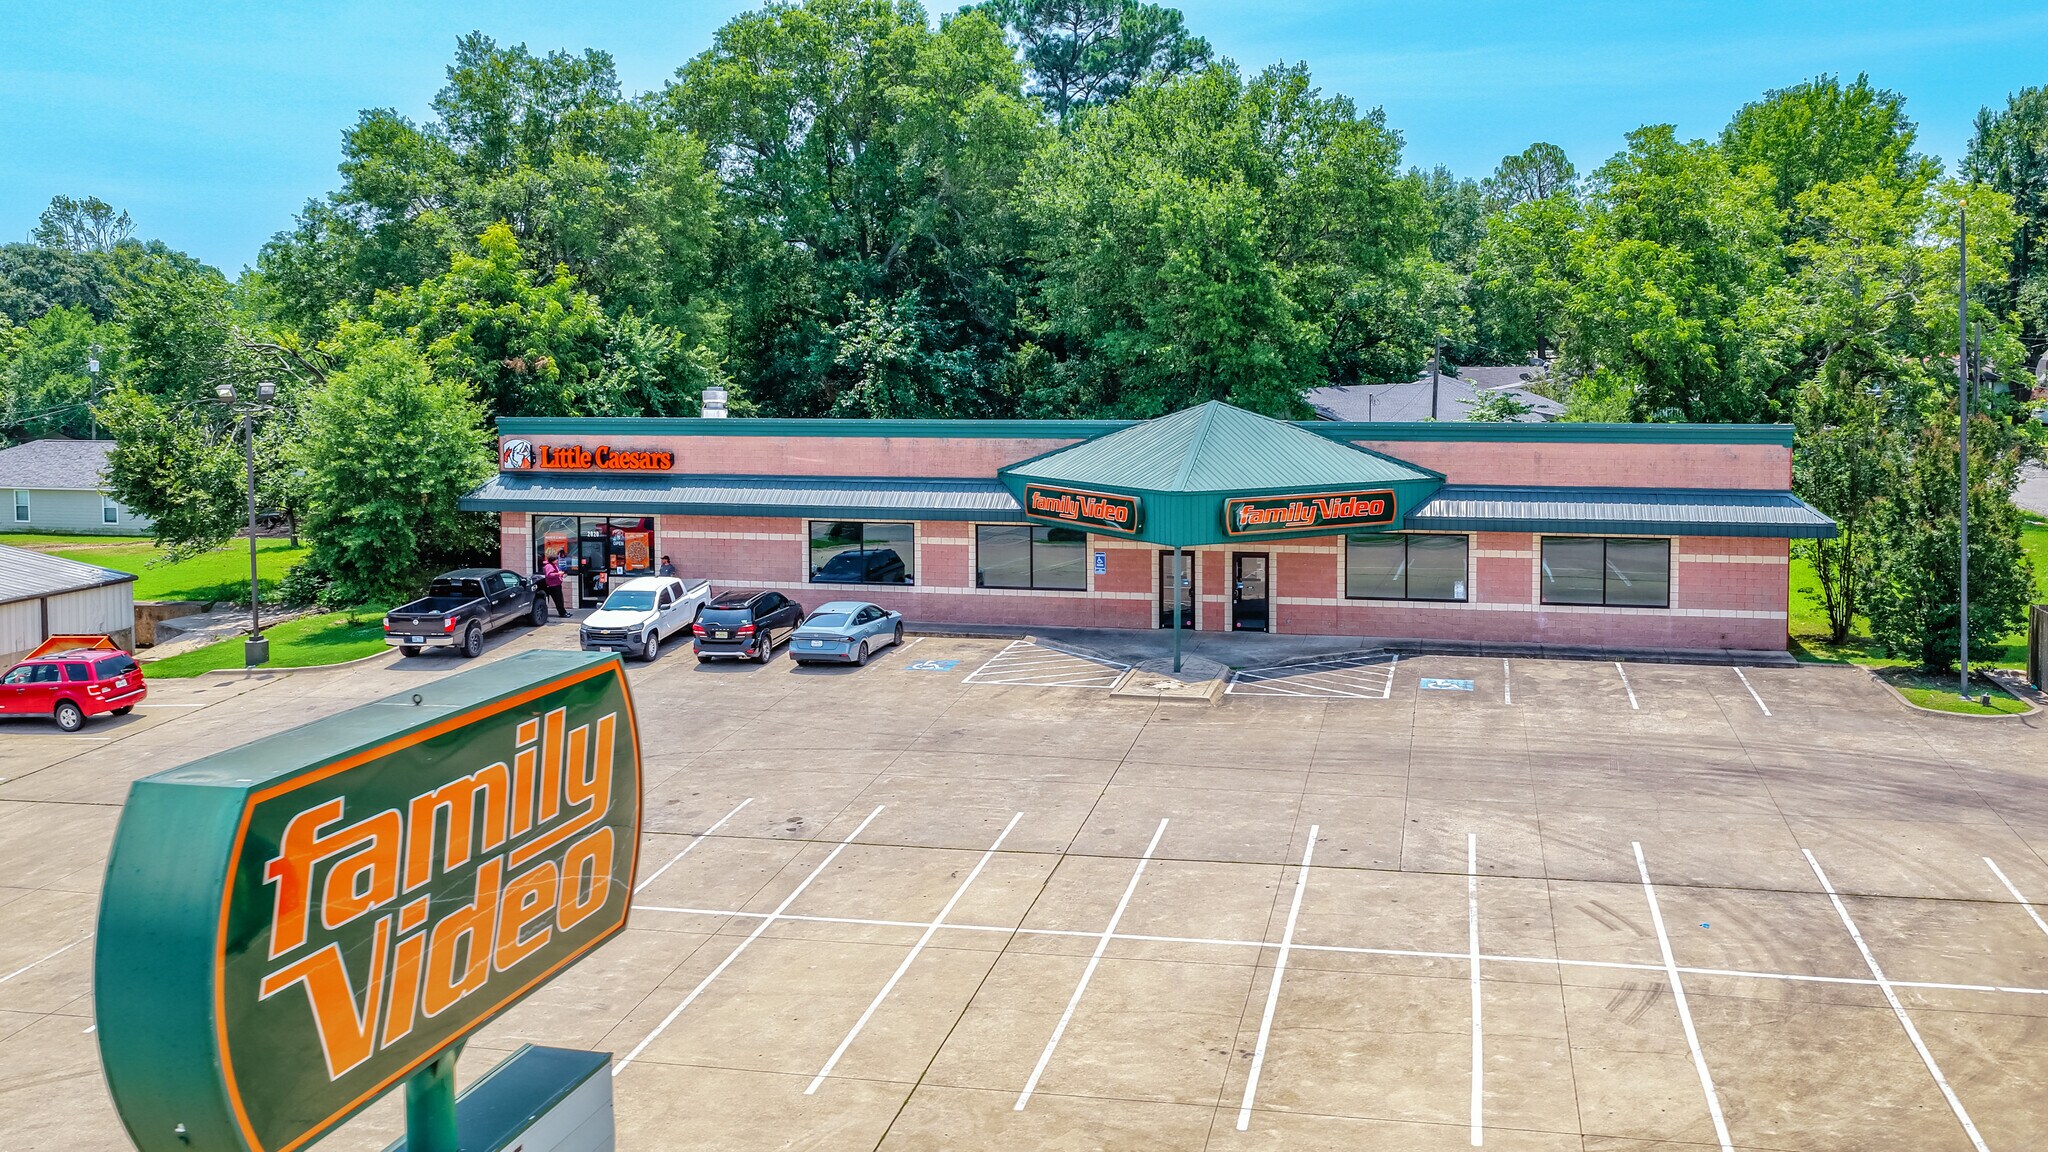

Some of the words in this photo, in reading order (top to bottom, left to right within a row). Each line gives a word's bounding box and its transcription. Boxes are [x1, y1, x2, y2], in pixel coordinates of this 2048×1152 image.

[539, 445, 592, 469] Little
[594, 445, 673, 470] Caesars
[1032, 491, 1079, 520] family
[1076, 495, 1128, 522] Video
[1240, 501, 1318, 527] family
[1312, 497, 1385, 519] Video
[263, 706, 617, 962] family
[258, 825, 615, 1081] Video
